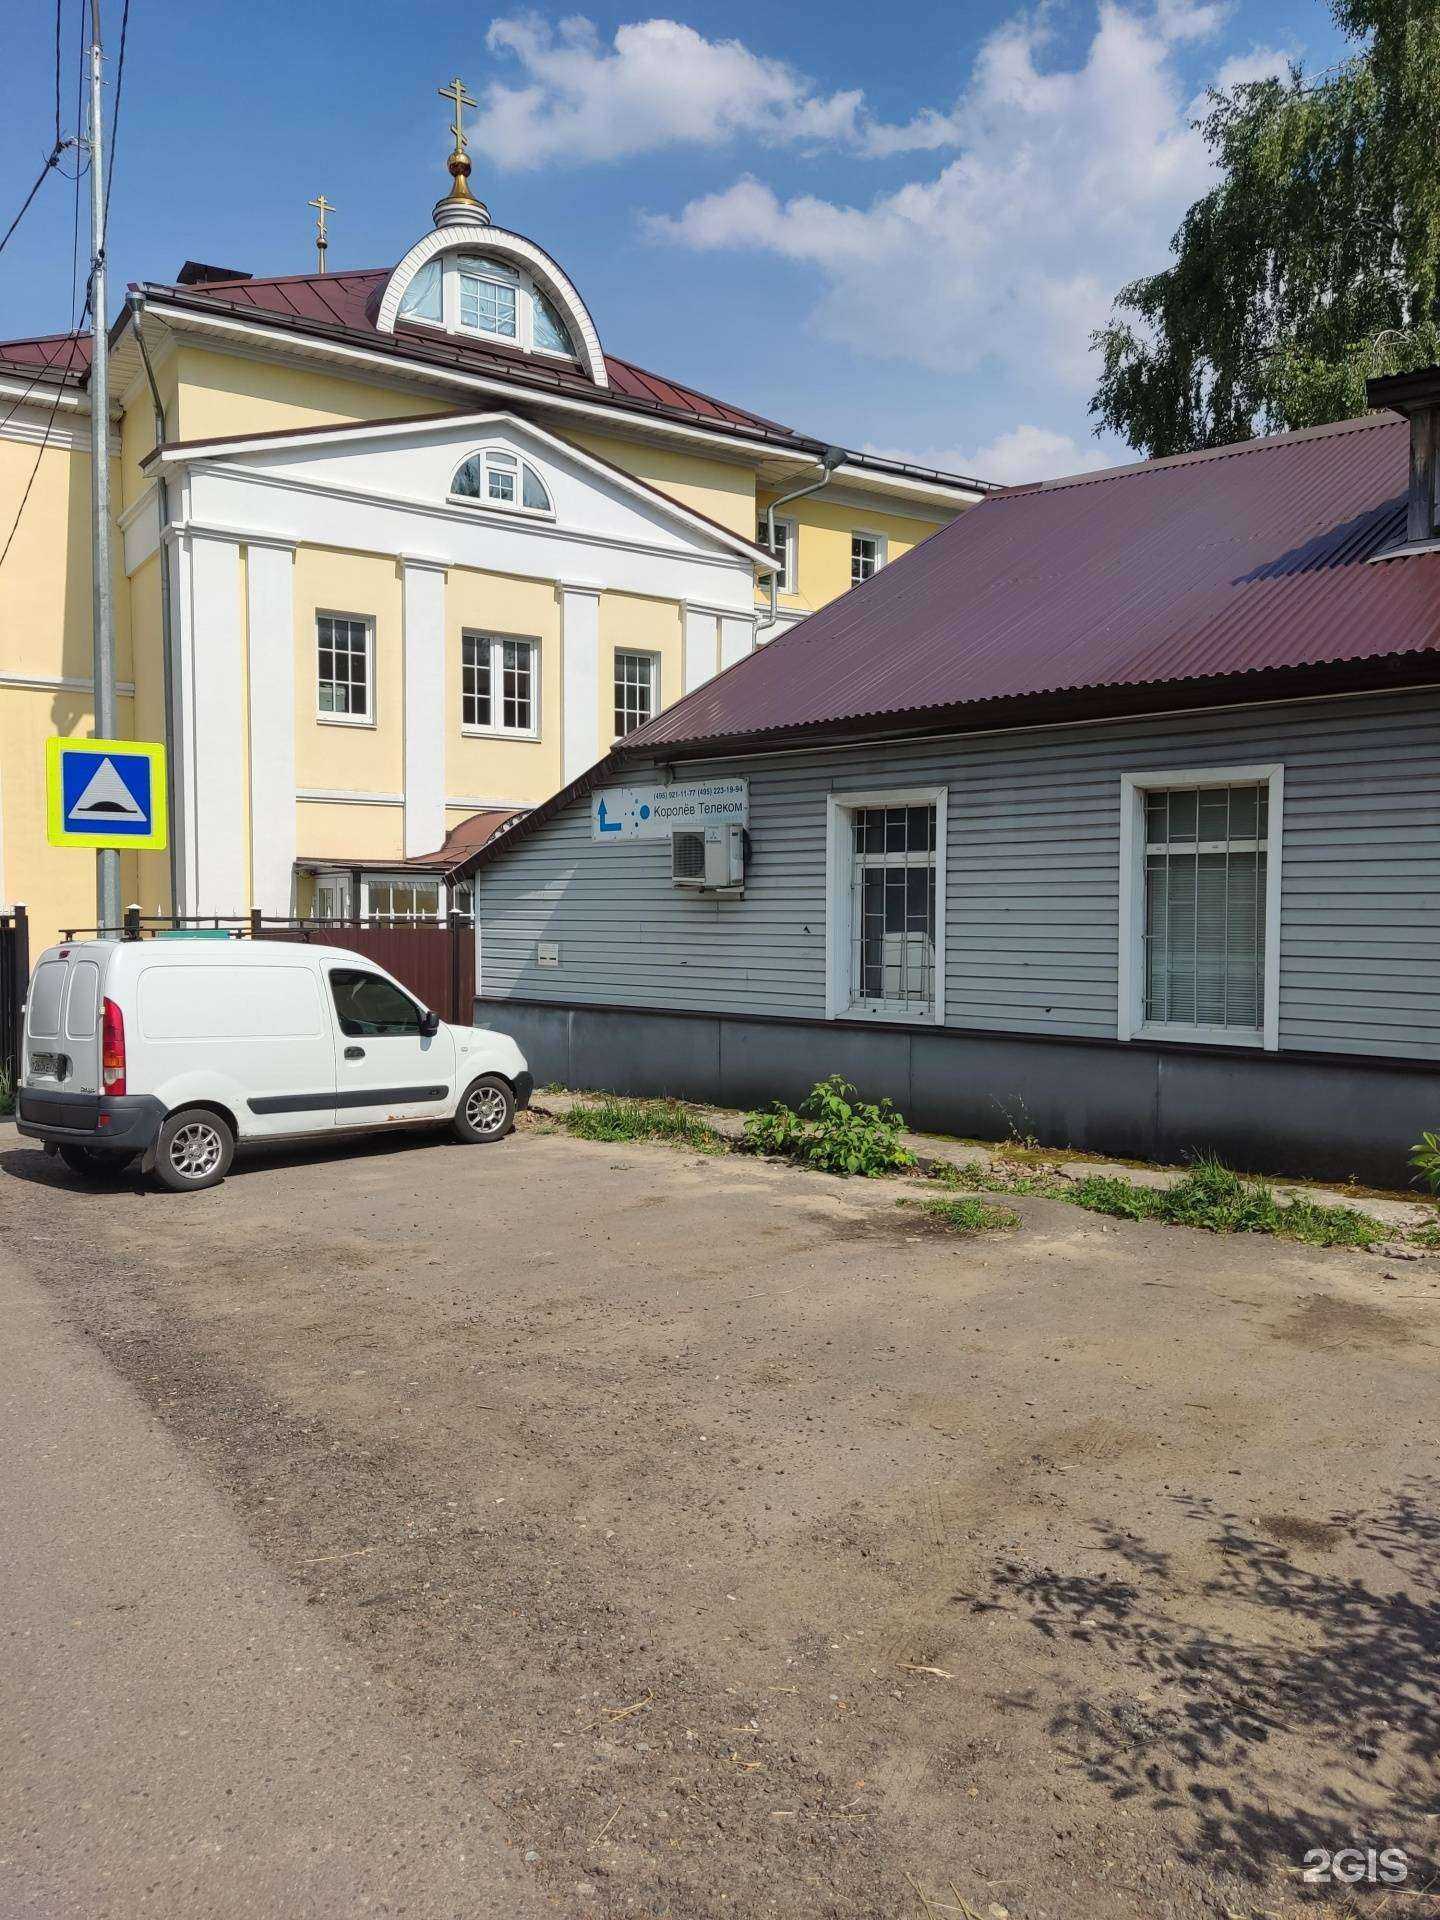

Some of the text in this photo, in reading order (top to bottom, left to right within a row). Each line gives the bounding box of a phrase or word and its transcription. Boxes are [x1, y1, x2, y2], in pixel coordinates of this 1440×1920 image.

[697, 787, 713, 797] (495)
[654, 802, 743, 818] Королёв Телеком
